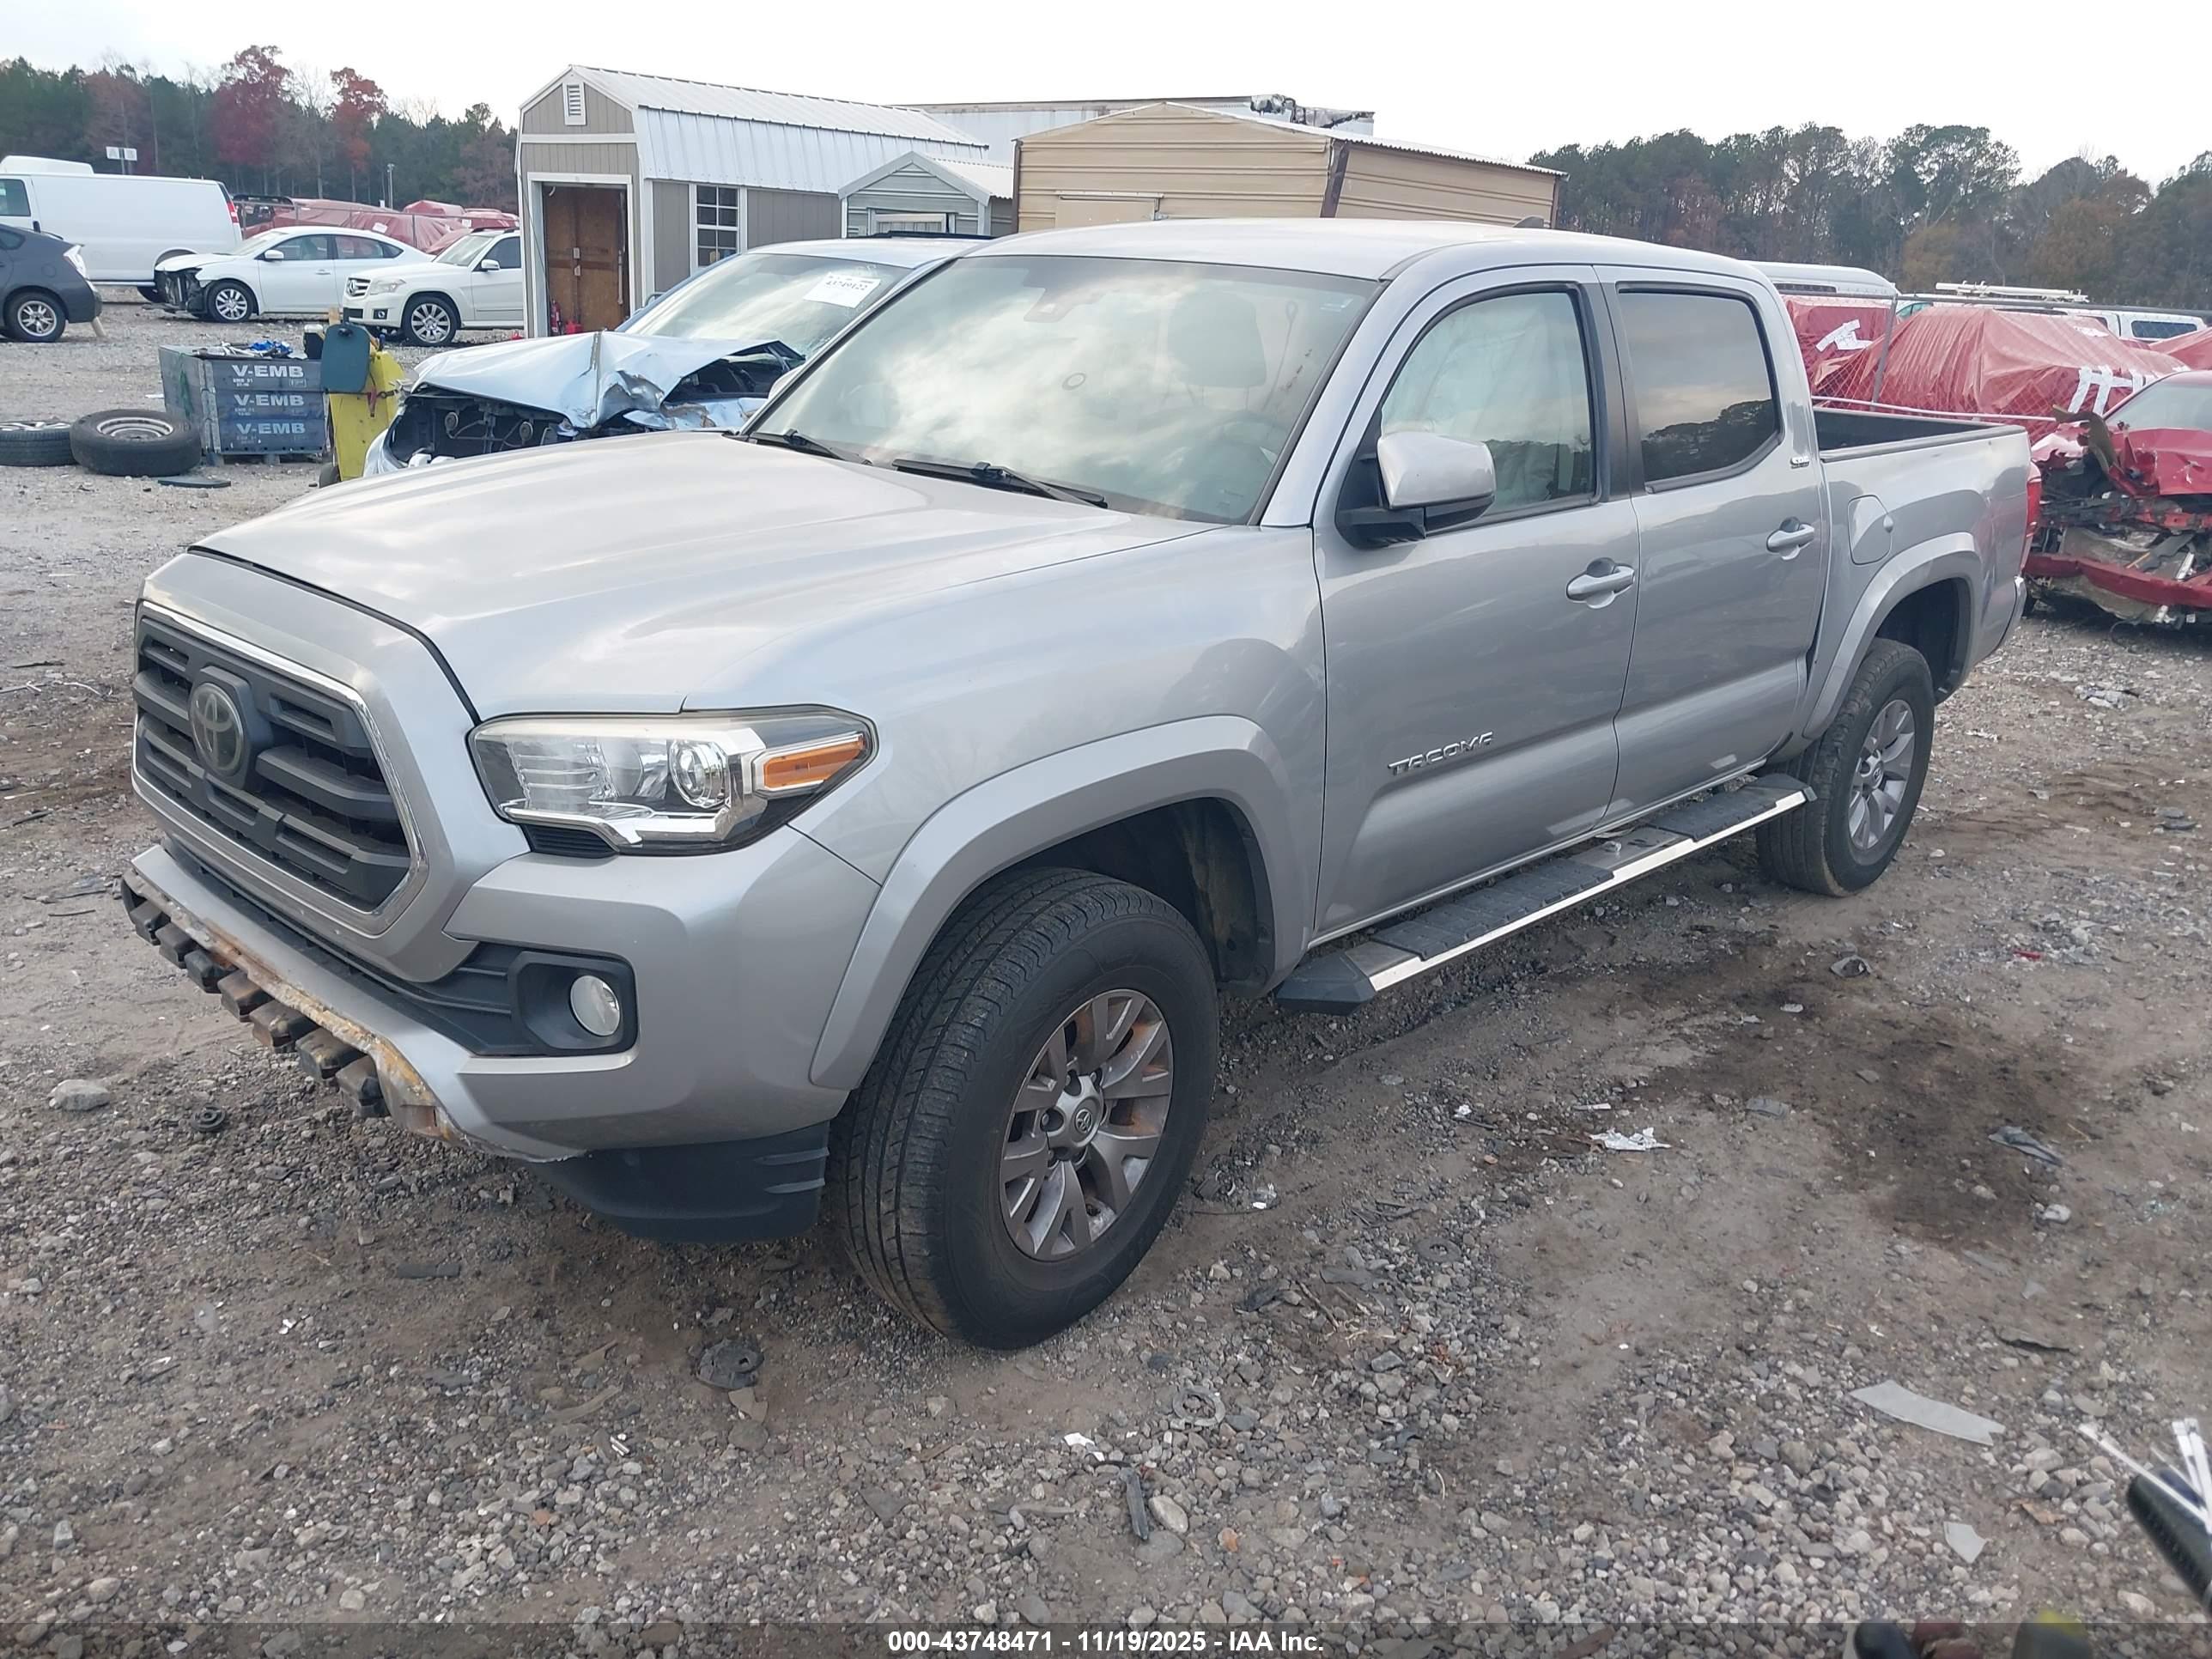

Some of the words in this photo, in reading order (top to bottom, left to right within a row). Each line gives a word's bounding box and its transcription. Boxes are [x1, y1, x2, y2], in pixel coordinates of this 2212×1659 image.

[231, 365, 304, 378] V-EMB
[234, 394, 305, 406] V-EMB
[236, 422, 306, 434] V-EMB
